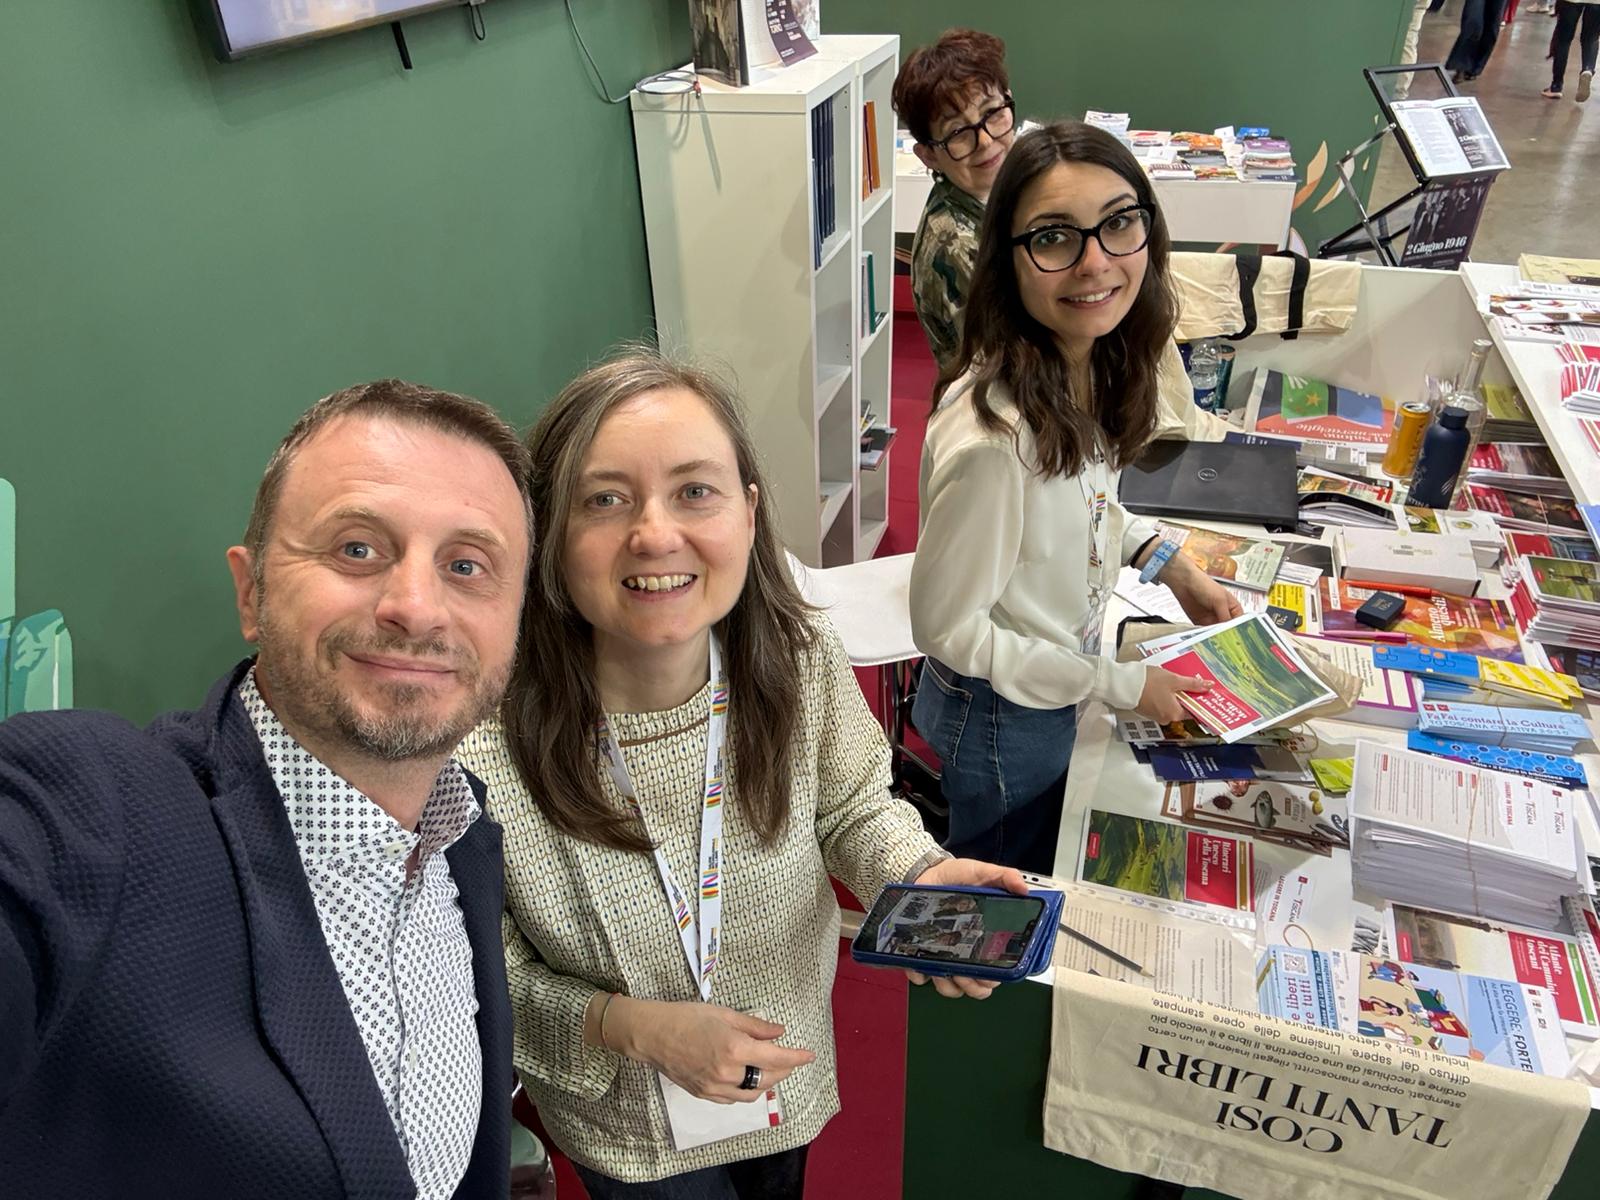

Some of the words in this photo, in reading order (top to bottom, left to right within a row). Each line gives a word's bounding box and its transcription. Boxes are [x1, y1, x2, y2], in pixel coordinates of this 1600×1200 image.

[1405, 244, 1414, 255] 2
[1413, 241, 1444, 256] Giugno
[1444, 236, 1468, 250] 1946
[1520, 720, 1566, 730] Cultura
[1269, 900, 1279, 921] TOSCANA
[1549, 944, 1563, 975] Atlante
[1284, 977, 1299, 1010] liberi
[1298, 979, 1312, 1006] tutti
[1151, 998, 1205, 1019] stampate,
[1150, 1014, 1168, 1024] più
[1212, 1014, 1246, 1030] opere
[1148, 1025, 1177, 1038] certo
[1170, 1020, 1208, 1035] veicolo
[1210, 1030, 1216, 1038] il
[1254, 1024, 1281, 1039] delle
[1500, 983, 1522, 1031] LEGGERE:
[1512, 1033, 1534, 1074] FORTE!
[1180, 1032, 1194, 1042] un
[1196, 1036, 1206, 1046] in
[1218, 1032, 1226, 1040] è
[1228, 1034, 1250, 1047] libro
[1348, 1034, 1380, 1047] detto
[1208, 1040, 1250, 1057] insieme
[1254, 1040, 1260, 1050] Il
[1263, 1042, 1320, 1063] copertina.
[1384, 1042, 1392, 1050] è
[1396, 1044, 1421, 1058] libri,
[1252, 1052, 1290, 1068] rilegati
[1322, 1058, 1344, 1068] una
[1350, 1048, 1392, 1066] sapere.
[1432, 1054, 1469, 1070] inclusi
[1133, 1042, 1277, 1104] LIBRI
[1346, 1063, 1361, 1072] da
[1401, 1060, 1420, 1072] del
[1293, 1064, 1360, 1085] manoscritti,
[1363, 1066, 1416, 1086] racchiusi
[1429, 1068, 1471, 1085] diffuso
[1362, 1079, 1404, 1096] oppure
[1418, 1079, 1426, 1087] e
[1428, 1082, 1467, 1098] ordine
[1408, 1089, 1462, 1109] stampati,
[1281, 1081, 1453, 1148] TANTI
[1215, 1100, 1344, 1153] COSÌ
